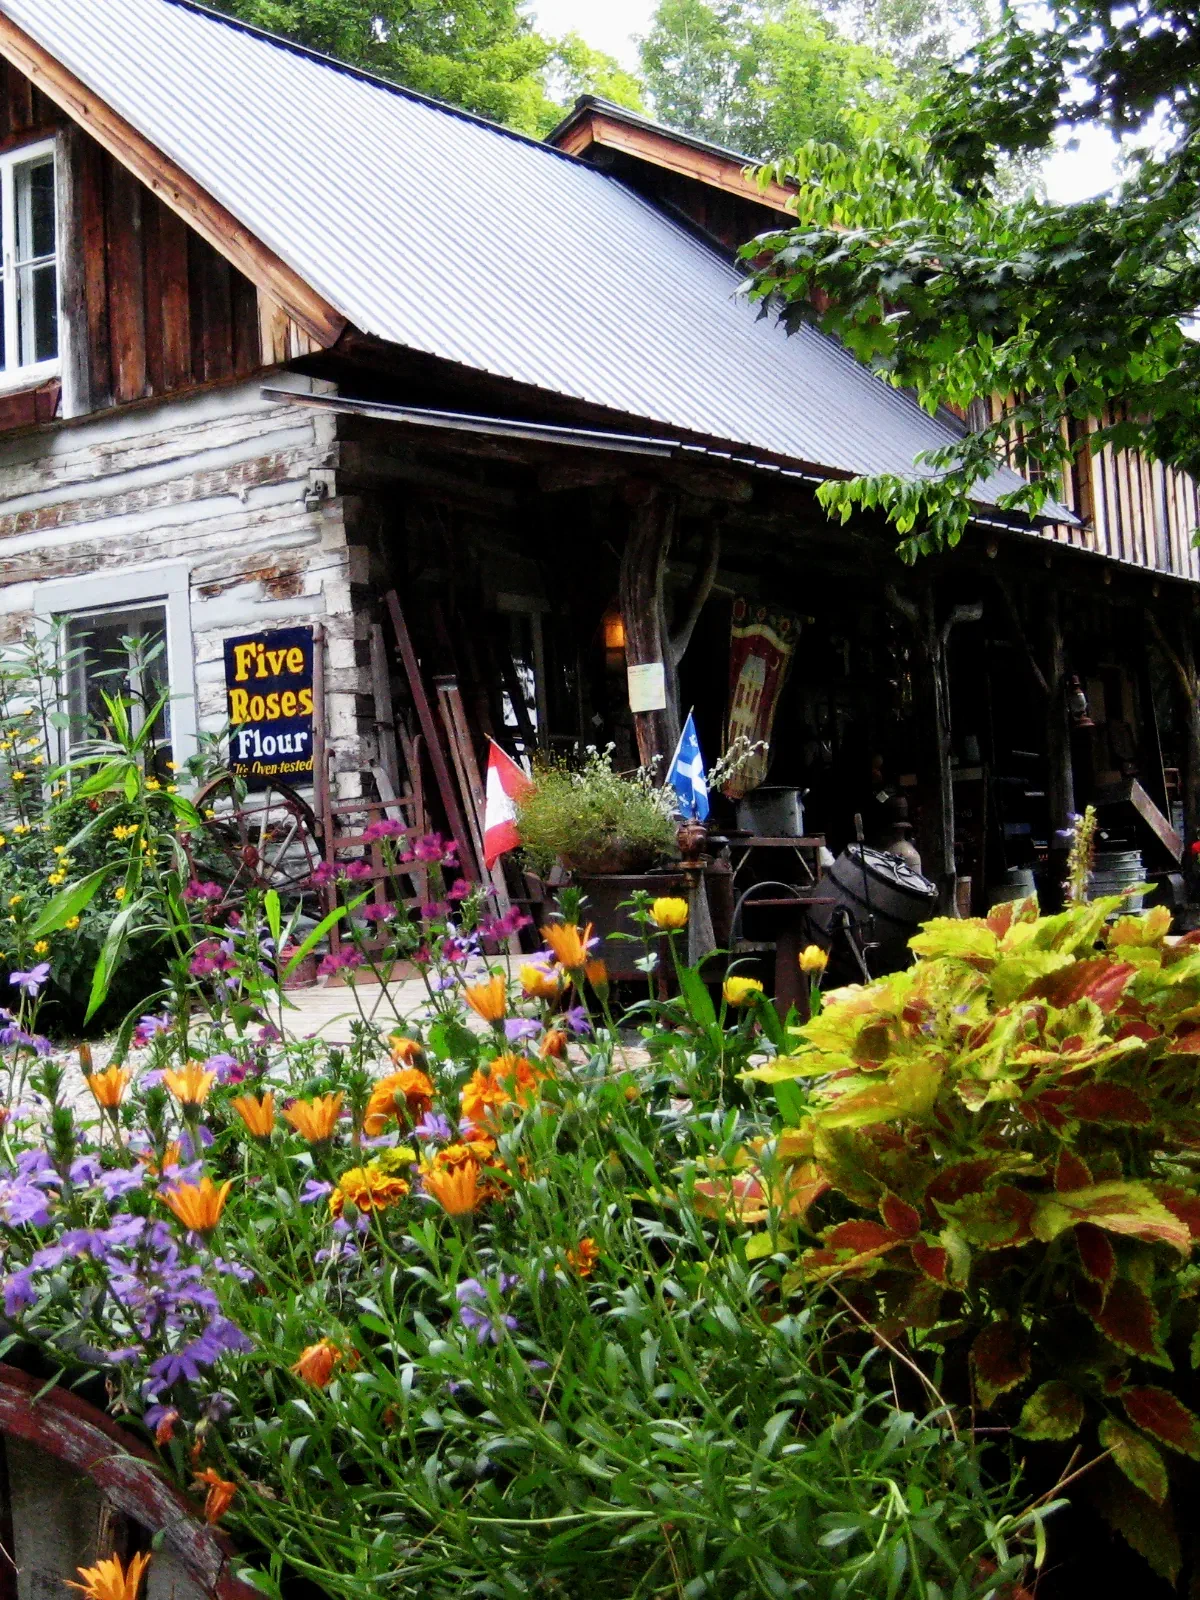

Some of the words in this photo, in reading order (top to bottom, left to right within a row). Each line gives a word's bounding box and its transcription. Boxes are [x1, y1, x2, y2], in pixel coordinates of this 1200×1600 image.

[234, 642, 303, 681] Five
[229, 687, 314, 725] Roses
[238, 729, 308, 759] Flour
